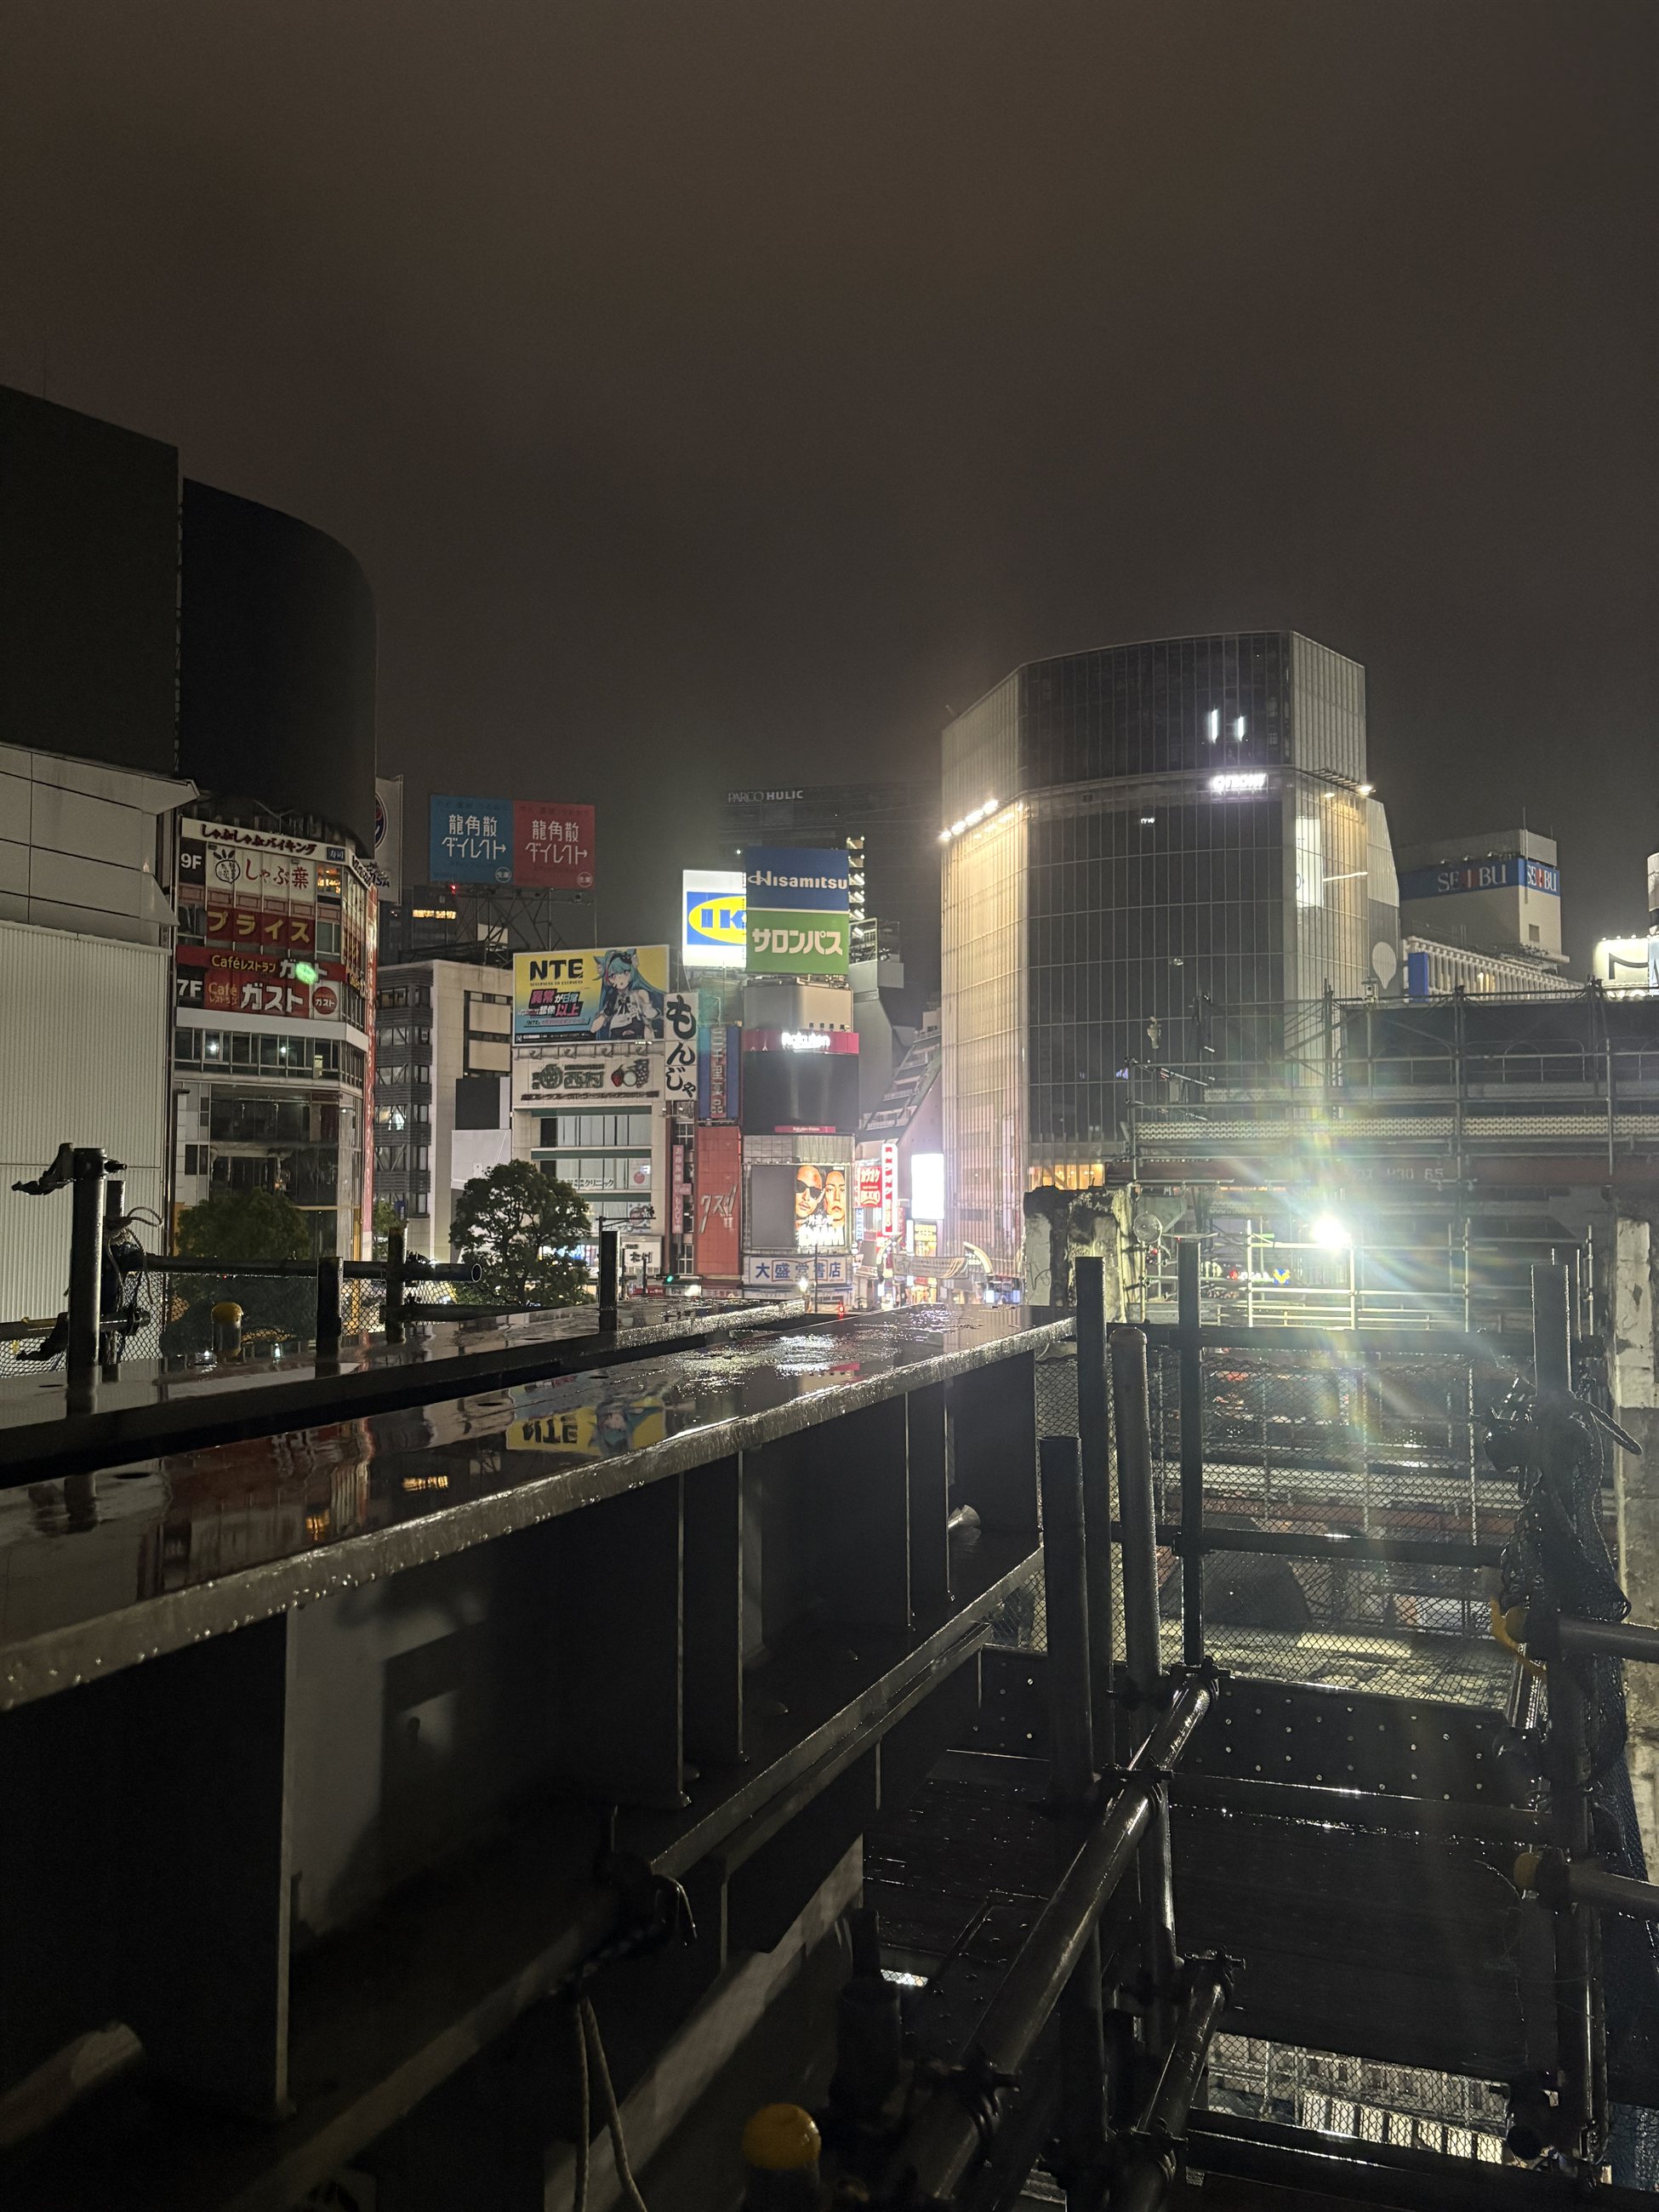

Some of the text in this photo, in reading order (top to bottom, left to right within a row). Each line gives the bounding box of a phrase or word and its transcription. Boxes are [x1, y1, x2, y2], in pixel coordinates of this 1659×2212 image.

[728, 790, 803, 802] PARCO HULIC
[449, 814, 498, 837] 龍角散
[532, 819, 579, 842] 龍角散
[201, 824, 317, 856] しゃぶしゃぶバイキング
[442, 837, 507, 860] ダイレクト
[180, 853, 202, 869] 9F
[525, 842, 588, 865] ダイレクト
[245, 858, 309, 890] しゃぶ葉
[747, 870, 848, 890] Hisamitsu
[1438, 864, 1507, 892] SEIBU
[1526, 864, 1557, 892] SEIBU
[208, 911, 310, 944] プライス
[752, 928, 843, 956] サロンパス
[529, 959, 584, 981] NTE
[177, 979, 203, 997] 7F
[208, 982, 238, 995] Café
[240, 983, 304, 1013] ガスト
[314, 998, 335, 1007] ガスト
[666, 994, 697, 1098] もんじゃ
[755, 1262, 841, 1279] 大盛堂書店
